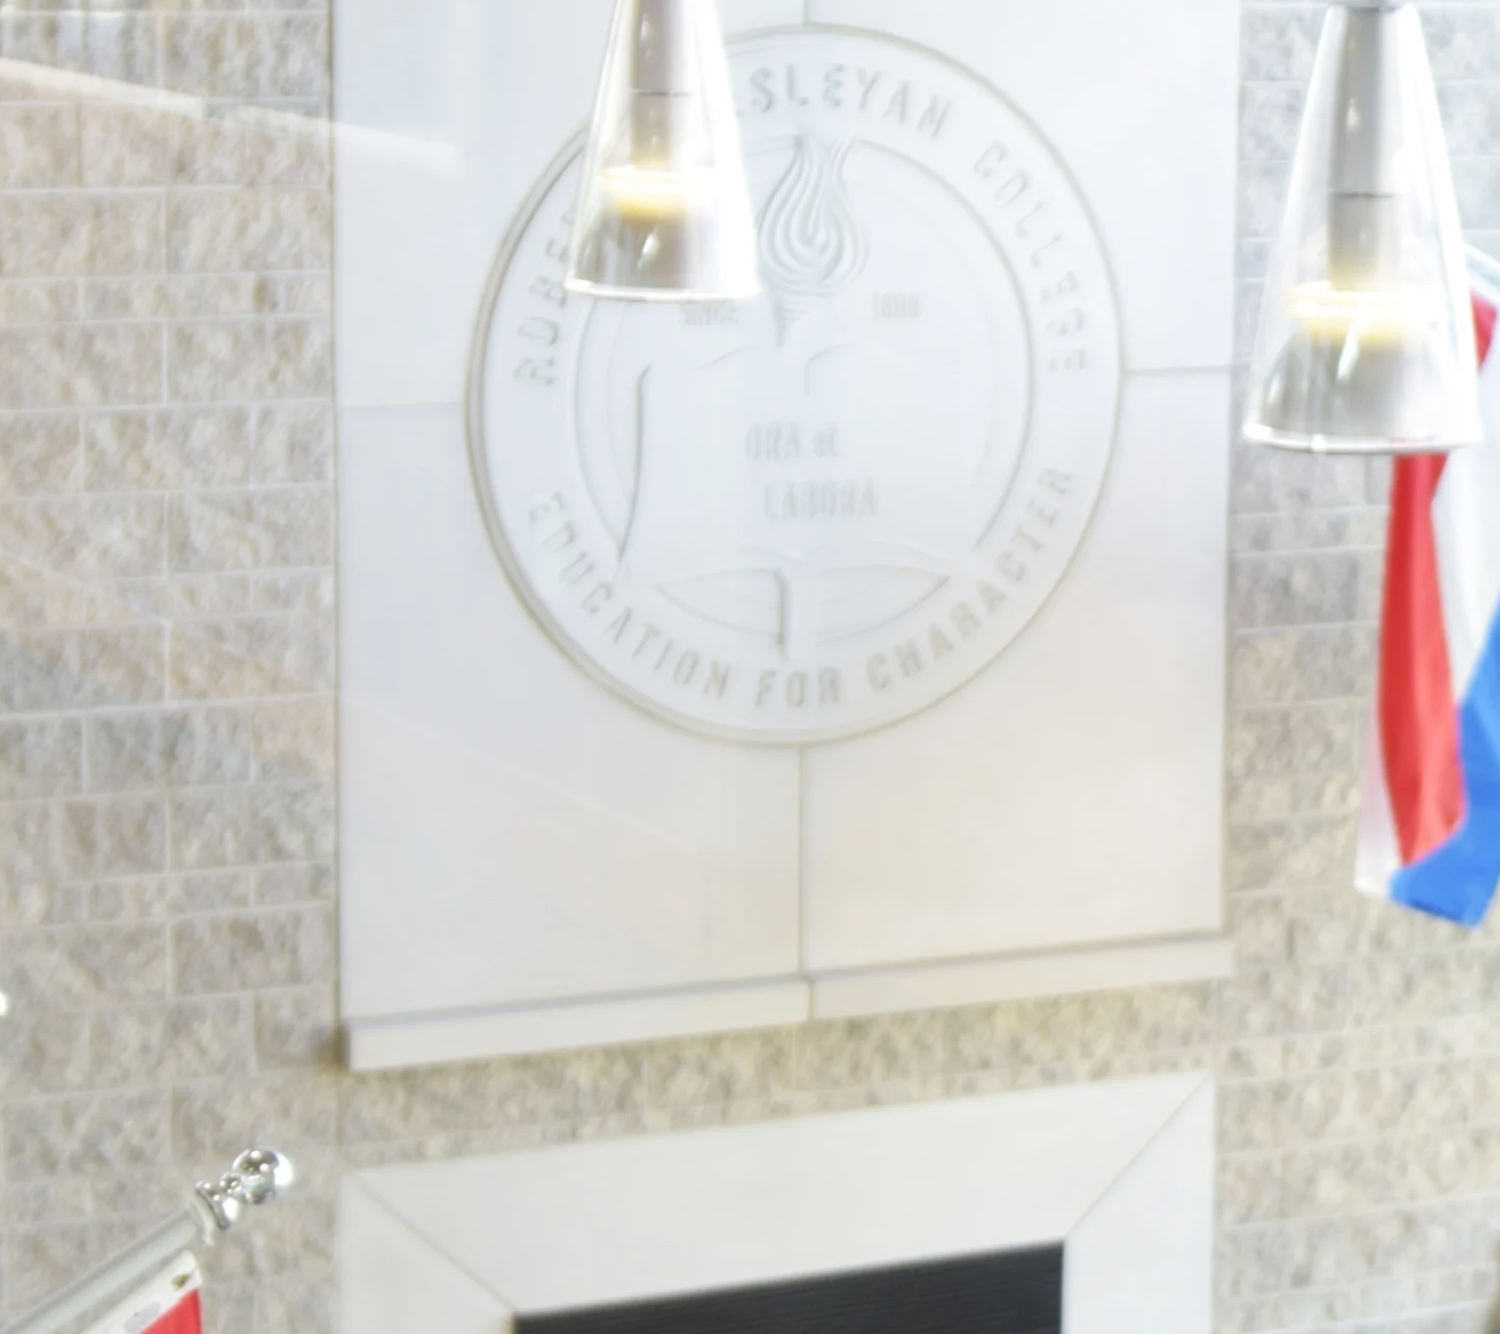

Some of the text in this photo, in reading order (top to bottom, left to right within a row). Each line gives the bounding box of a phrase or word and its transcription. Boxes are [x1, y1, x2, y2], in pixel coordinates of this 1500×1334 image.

[735, 62, 954, 142] SLEYAN
[971, 138, 1091, 375] COLLEGE
[745, 421, 803, 461] ORA
[764, 479, 879, 521] LABORA
[527, 464, 1075, 708] EDUCATION FOR CHARACTER
